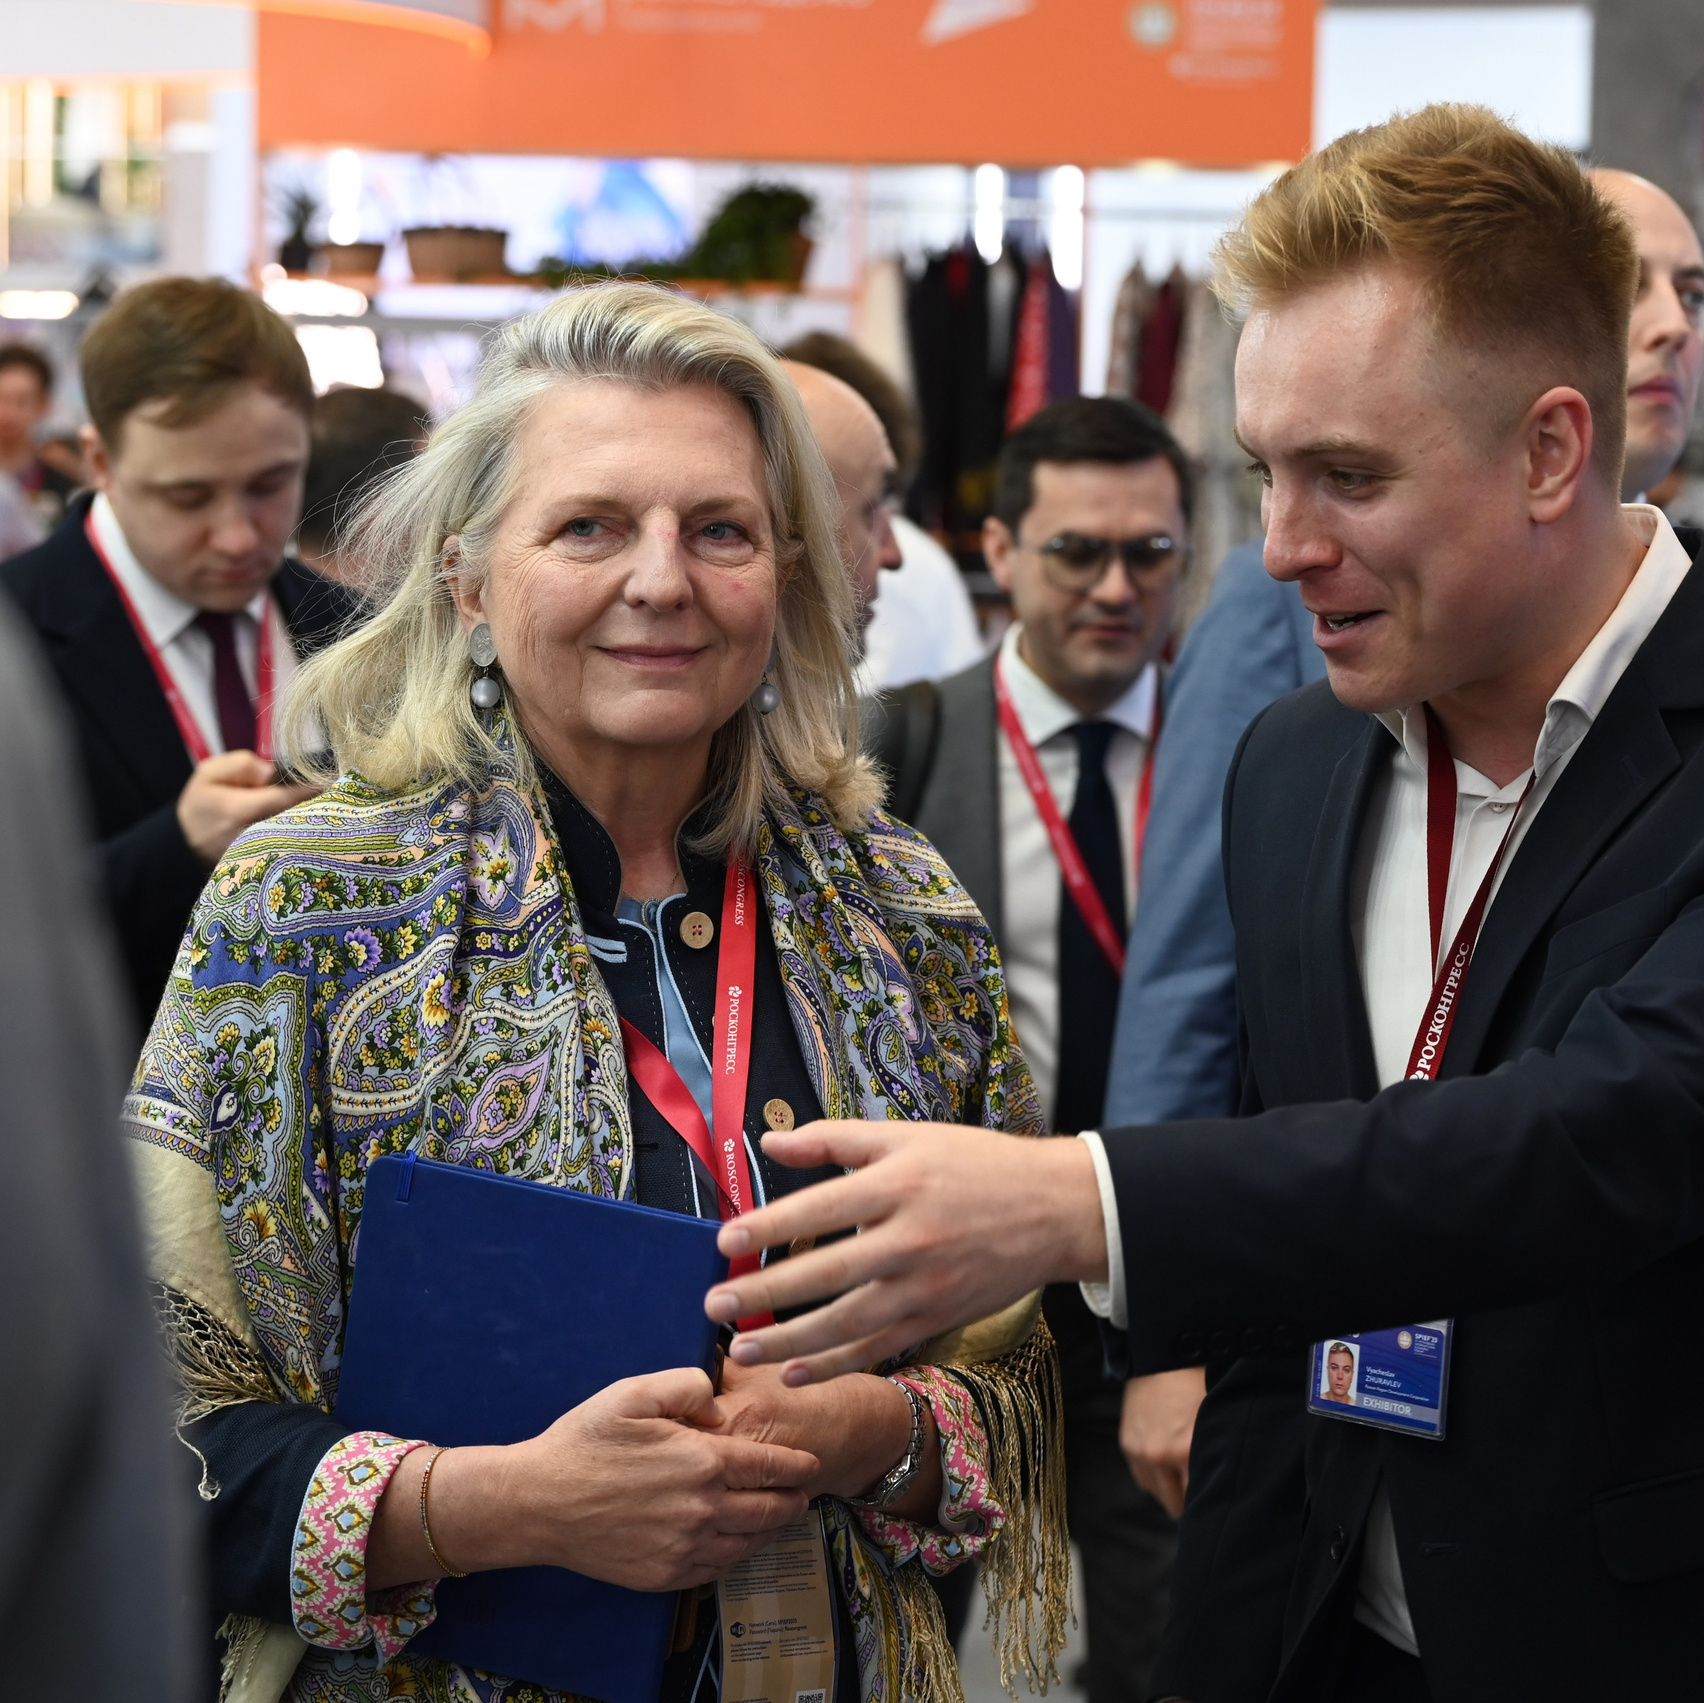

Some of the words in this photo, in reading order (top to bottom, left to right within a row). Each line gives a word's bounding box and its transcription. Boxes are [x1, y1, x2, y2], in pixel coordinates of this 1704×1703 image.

[734, 854, 746, 926] OSCONGRESS
[1417, 942, 1470, 1070] РОСКОНГРЕСС
[726, 998, 740, 1074] РОСКОНГРЕСС
[1365, 1375, 1402, 1388] ZHURAVLEV
[1366, 1366, 1396, 1378] Vyacheslav
[1363, 1397, 1412, 1416] EXHIBITOR
